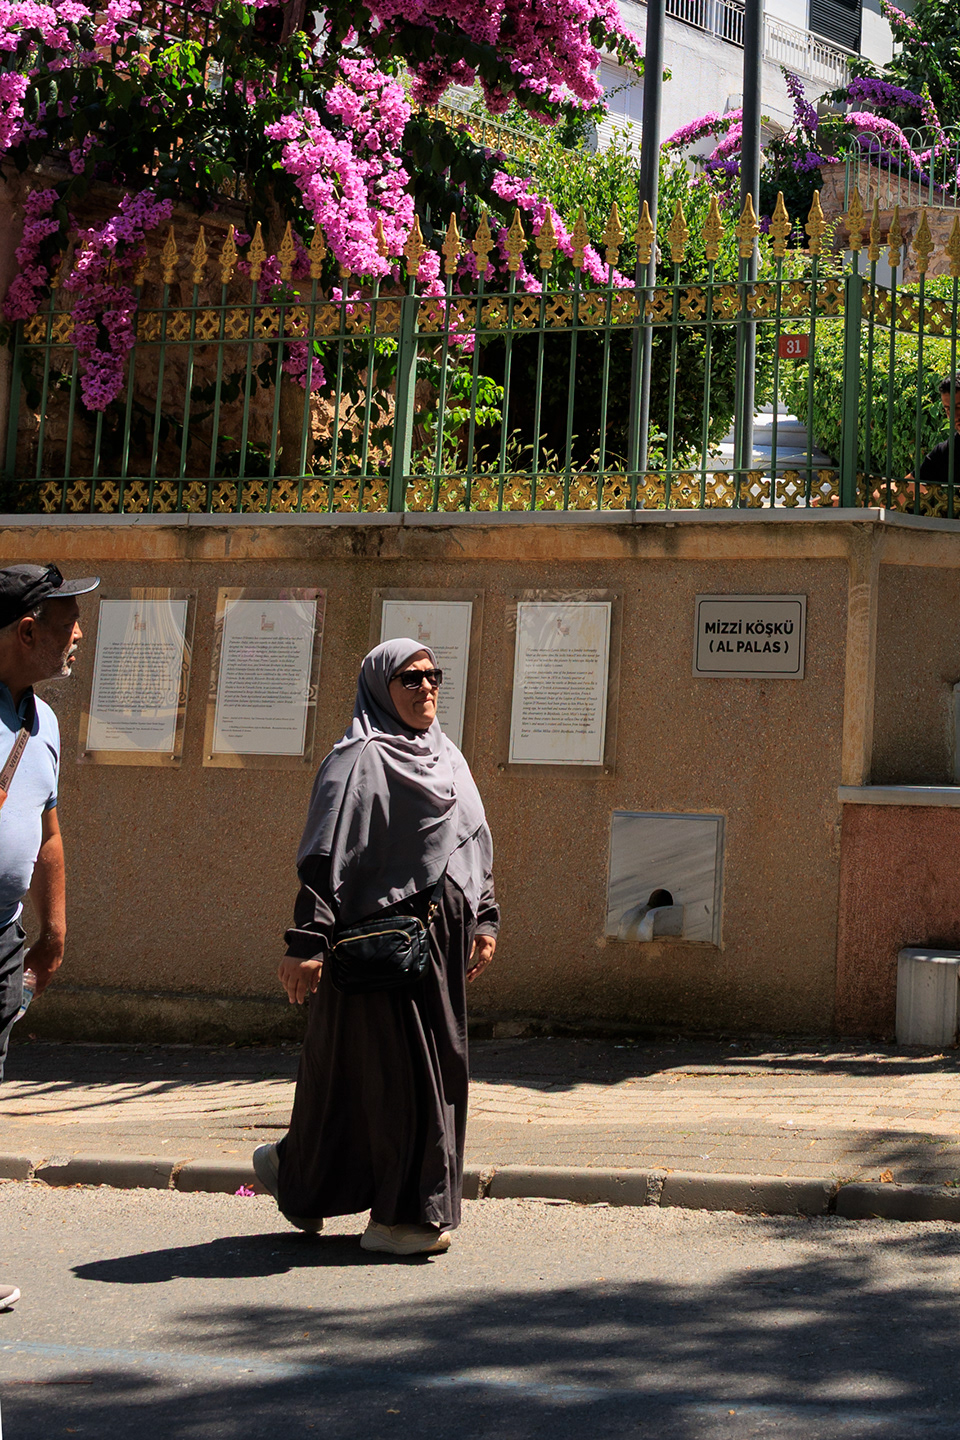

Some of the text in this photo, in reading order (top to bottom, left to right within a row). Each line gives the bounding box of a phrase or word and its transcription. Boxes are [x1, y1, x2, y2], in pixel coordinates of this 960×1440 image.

[786, 339, 802, 354] 31
[705, 619, 794, 638] MİZZİ KÖŞKÜ
